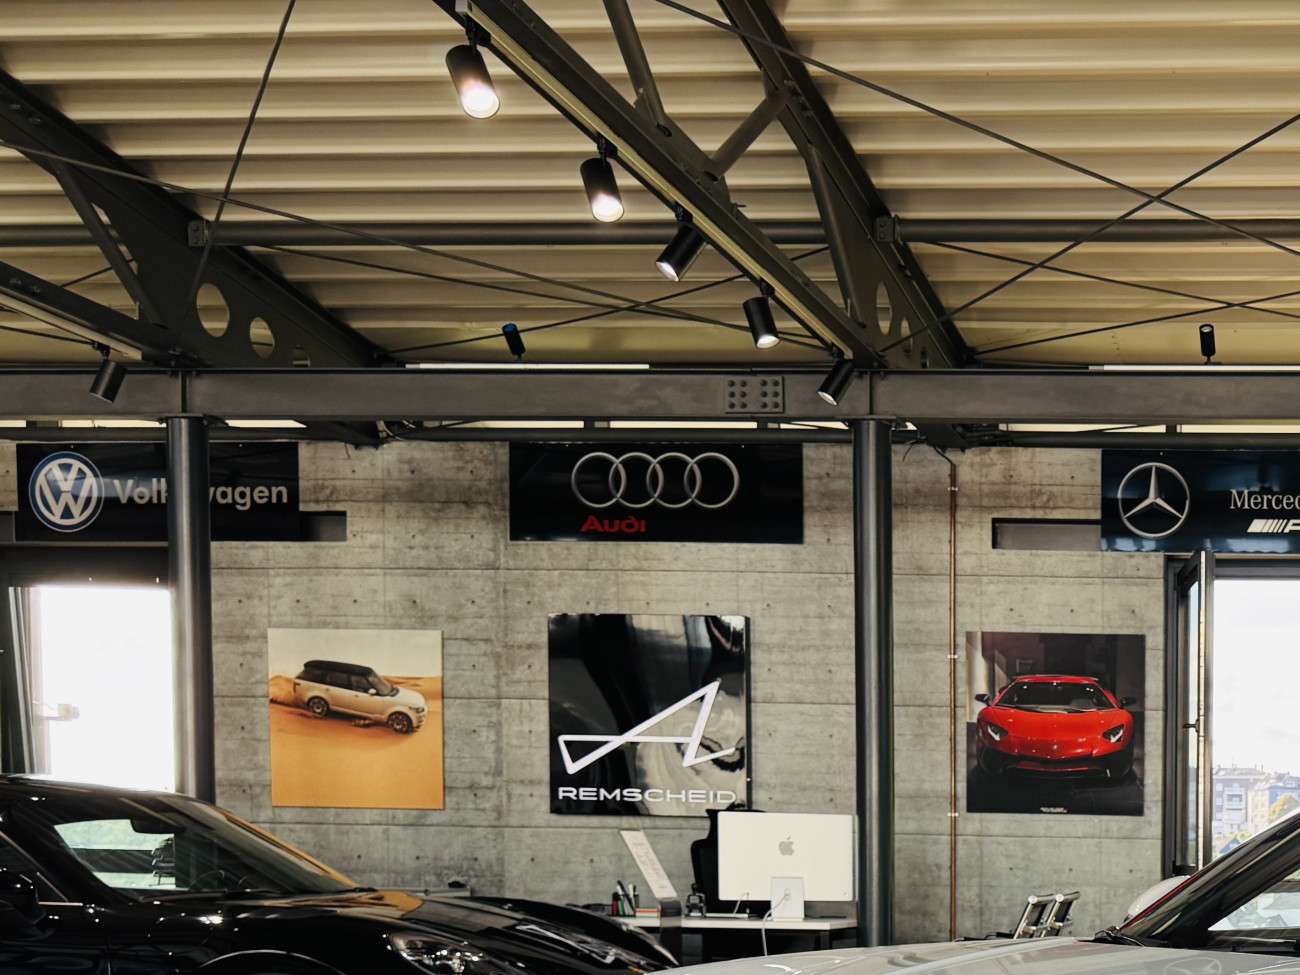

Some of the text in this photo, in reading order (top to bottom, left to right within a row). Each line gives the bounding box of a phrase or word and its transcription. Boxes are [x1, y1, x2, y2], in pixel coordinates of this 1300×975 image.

[113, 478, 288, 511] Volagen
[581, 515, 646, 533] Audi
[558, 786, 736, 804] REMSCHEID
